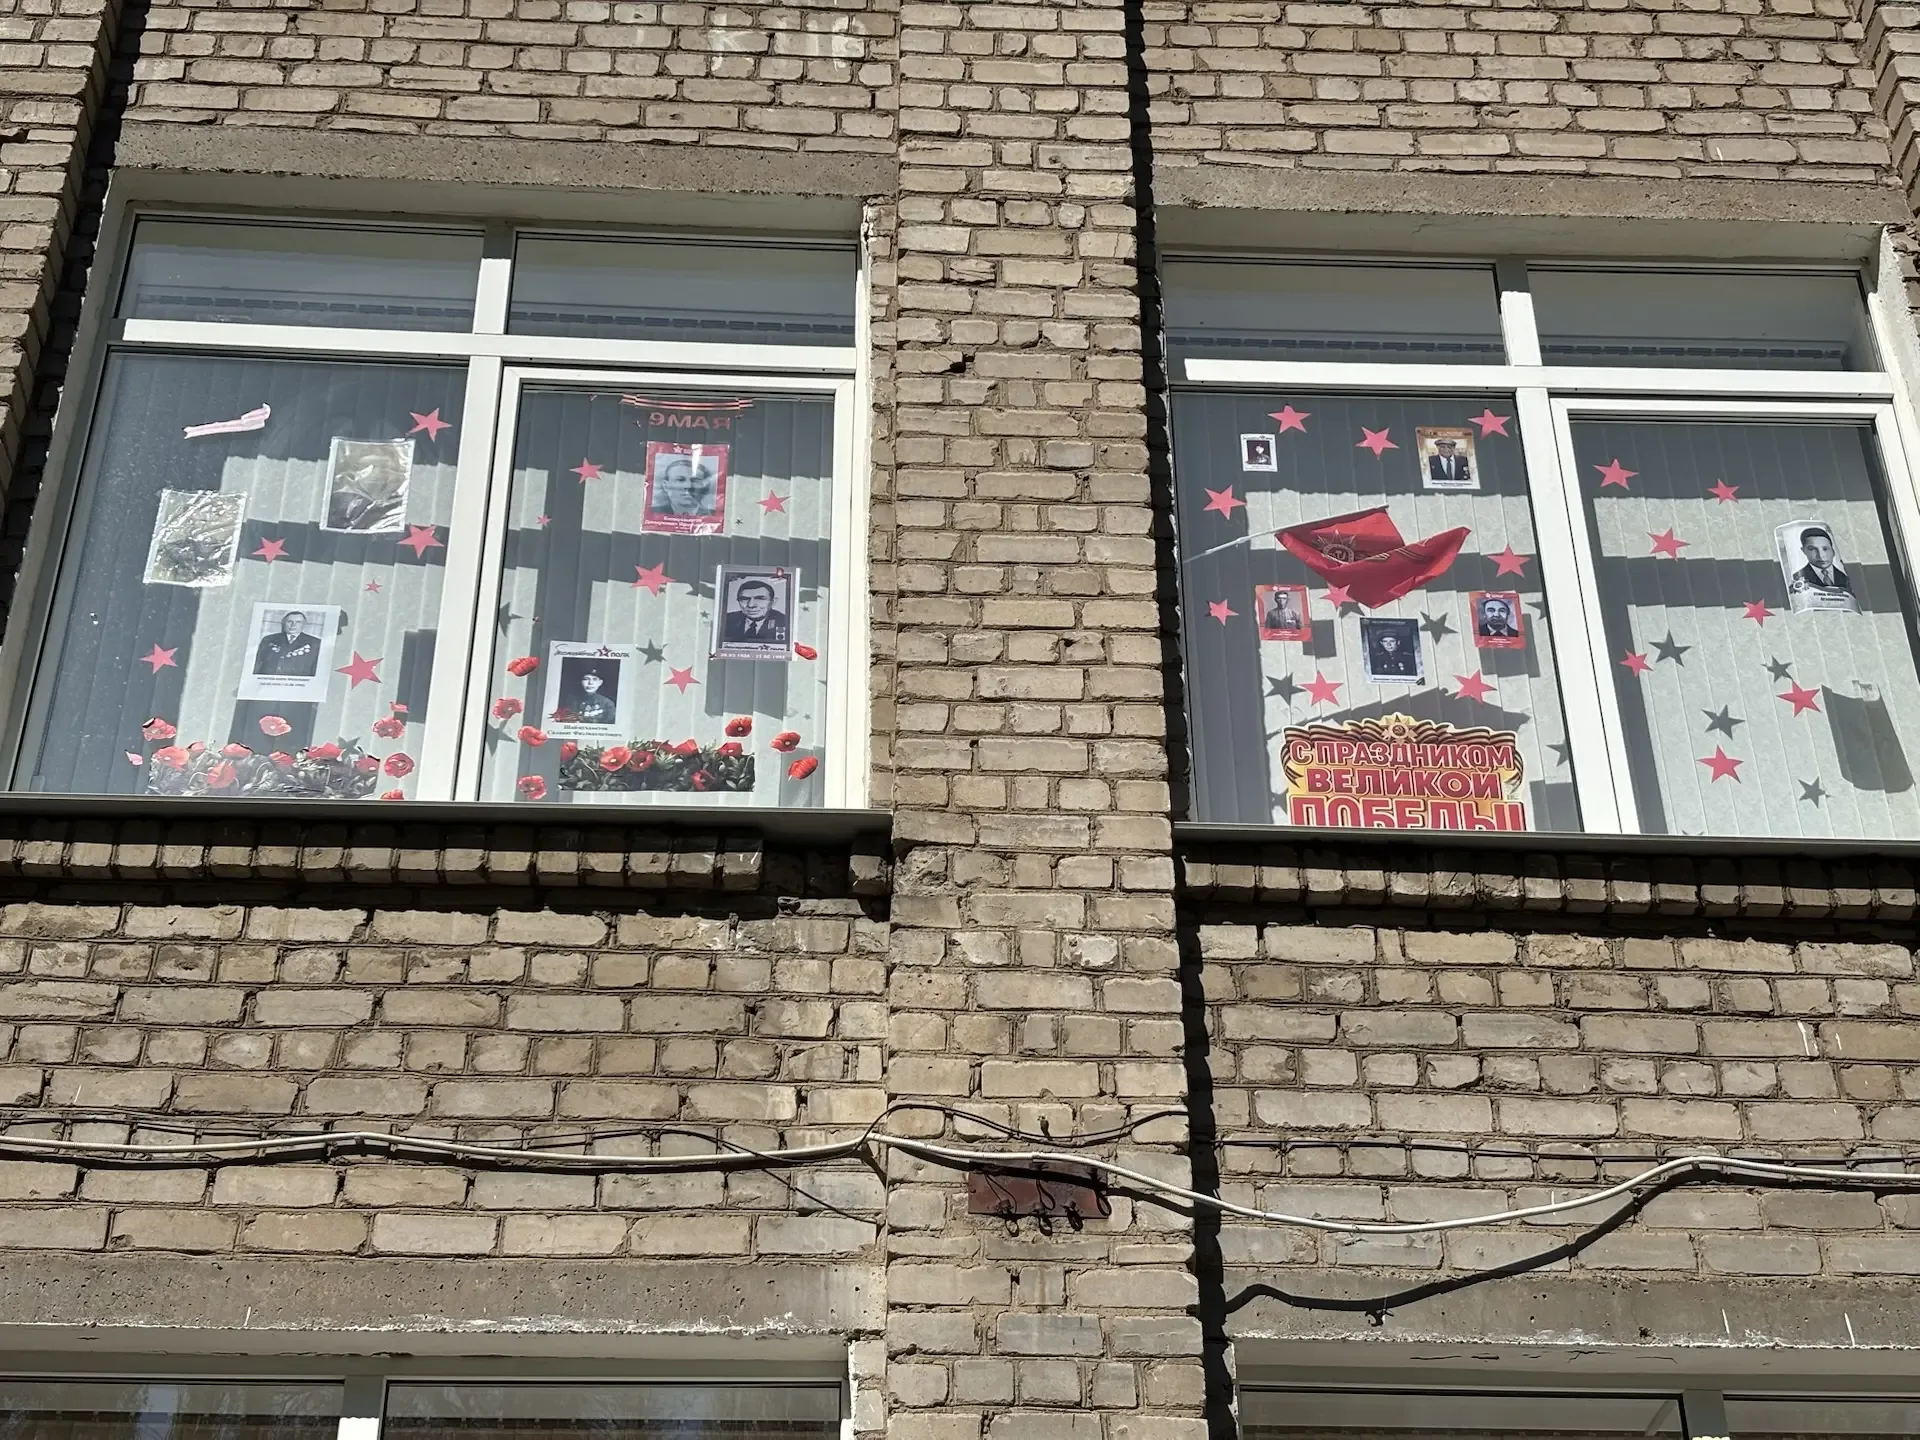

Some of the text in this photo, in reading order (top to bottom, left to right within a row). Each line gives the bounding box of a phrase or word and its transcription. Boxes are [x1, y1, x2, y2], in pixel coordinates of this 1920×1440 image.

[1290, 740, 1516, 770] С ПРАЗДНИКОМ
[1306, 766, 1504, 800] ВЕЛИКОЙ
